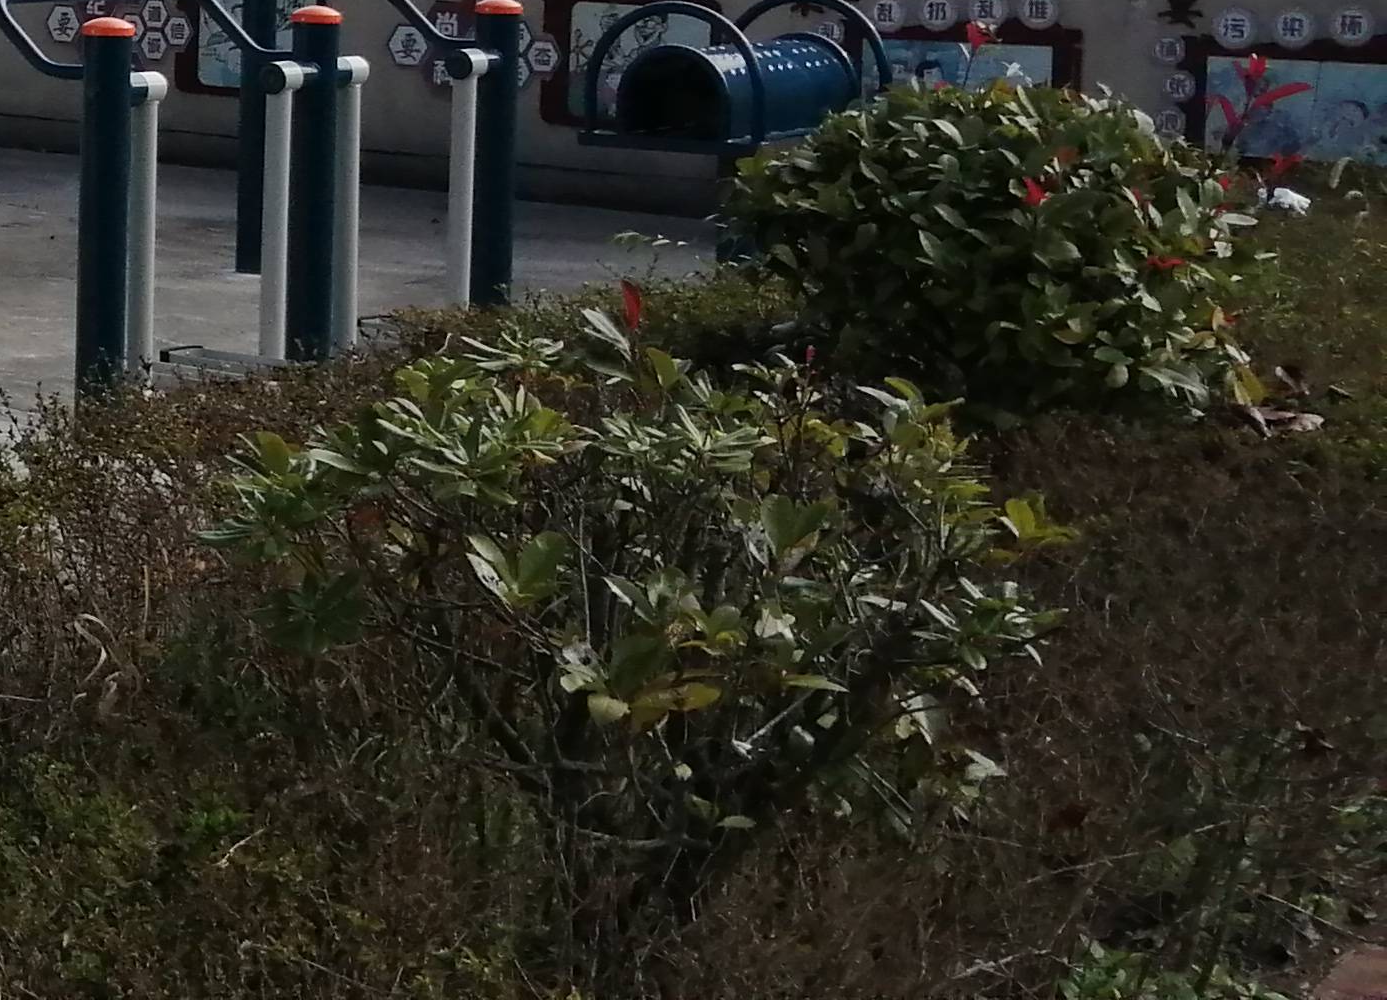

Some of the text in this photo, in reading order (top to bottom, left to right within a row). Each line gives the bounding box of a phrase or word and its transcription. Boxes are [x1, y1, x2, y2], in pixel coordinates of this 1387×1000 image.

[877, 0, 1048, 23] 乱扔乱堆
[395, 33, 422, 62] 要
